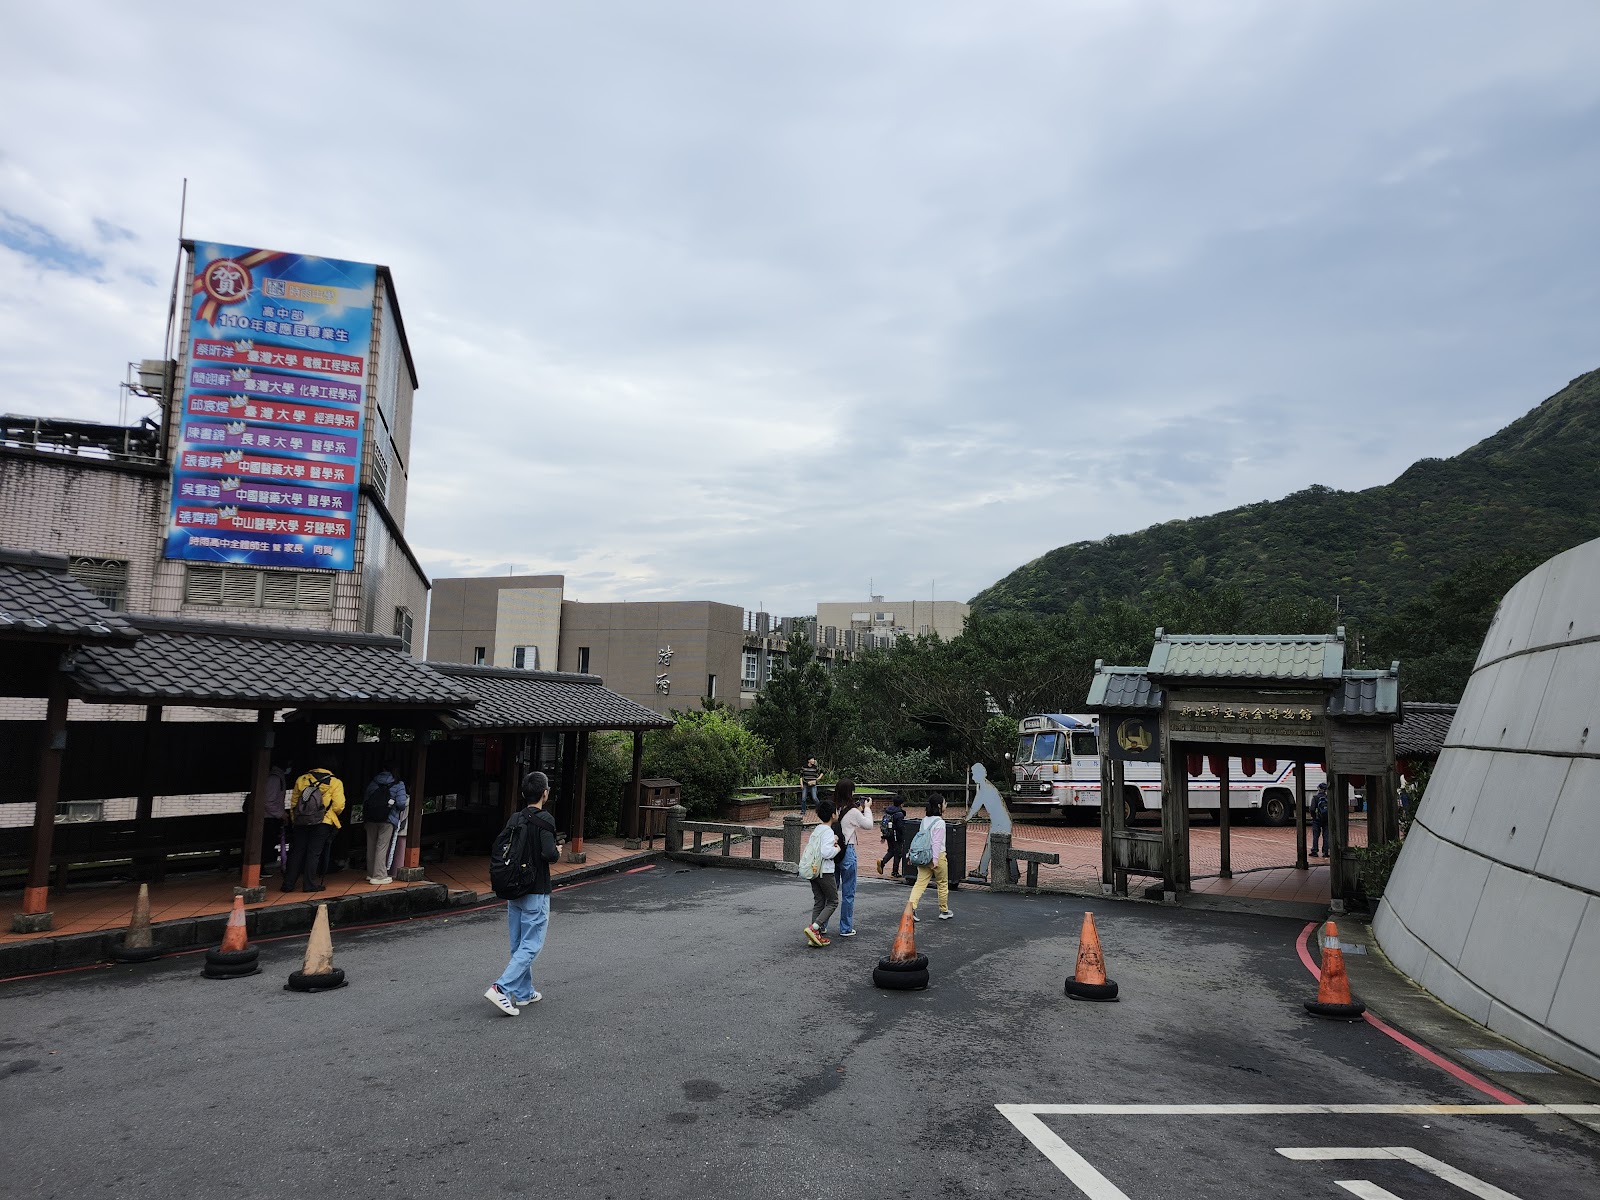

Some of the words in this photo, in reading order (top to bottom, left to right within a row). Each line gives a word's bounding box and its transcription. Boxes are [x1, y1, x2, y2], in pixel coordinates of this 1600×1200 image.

[212, 267, 242, 295] 賀
[262, 306, 304, 322] 高中部
[219, 314, 349, 342] 110年度應屆畢業生
[247, 351, 297, 368] 臺灣大學
[303, 356, 360, 373] 電機工程學系
[244, 379, 295, 396] 臺灣大學
[300, 385, 357, 401] 化學工程學系
[244, 406, 306, 423] 臺灣大學
[314, 412, 355, 428] 經濟學系
[241, 433, 303, 450] 長庚大學
[311, 439, 346, 454] 醫學系
[239, 461, 305, 478] 中國醫藥大學
[310, 466, 345, 480] 醫學系
[236, 489, 302, 506] 中國醫藥大學
[308, 494, 343, 508] 醫學系
[232, 516, 299, 533] 中山醫學大學
[304, 520, 345, 536] 牙醫學系
[189, 536, 269, 552] 時雨高中全體師生
[283, 542, 304, 554] 家長
[313, 544, 334, 556] 同賀
